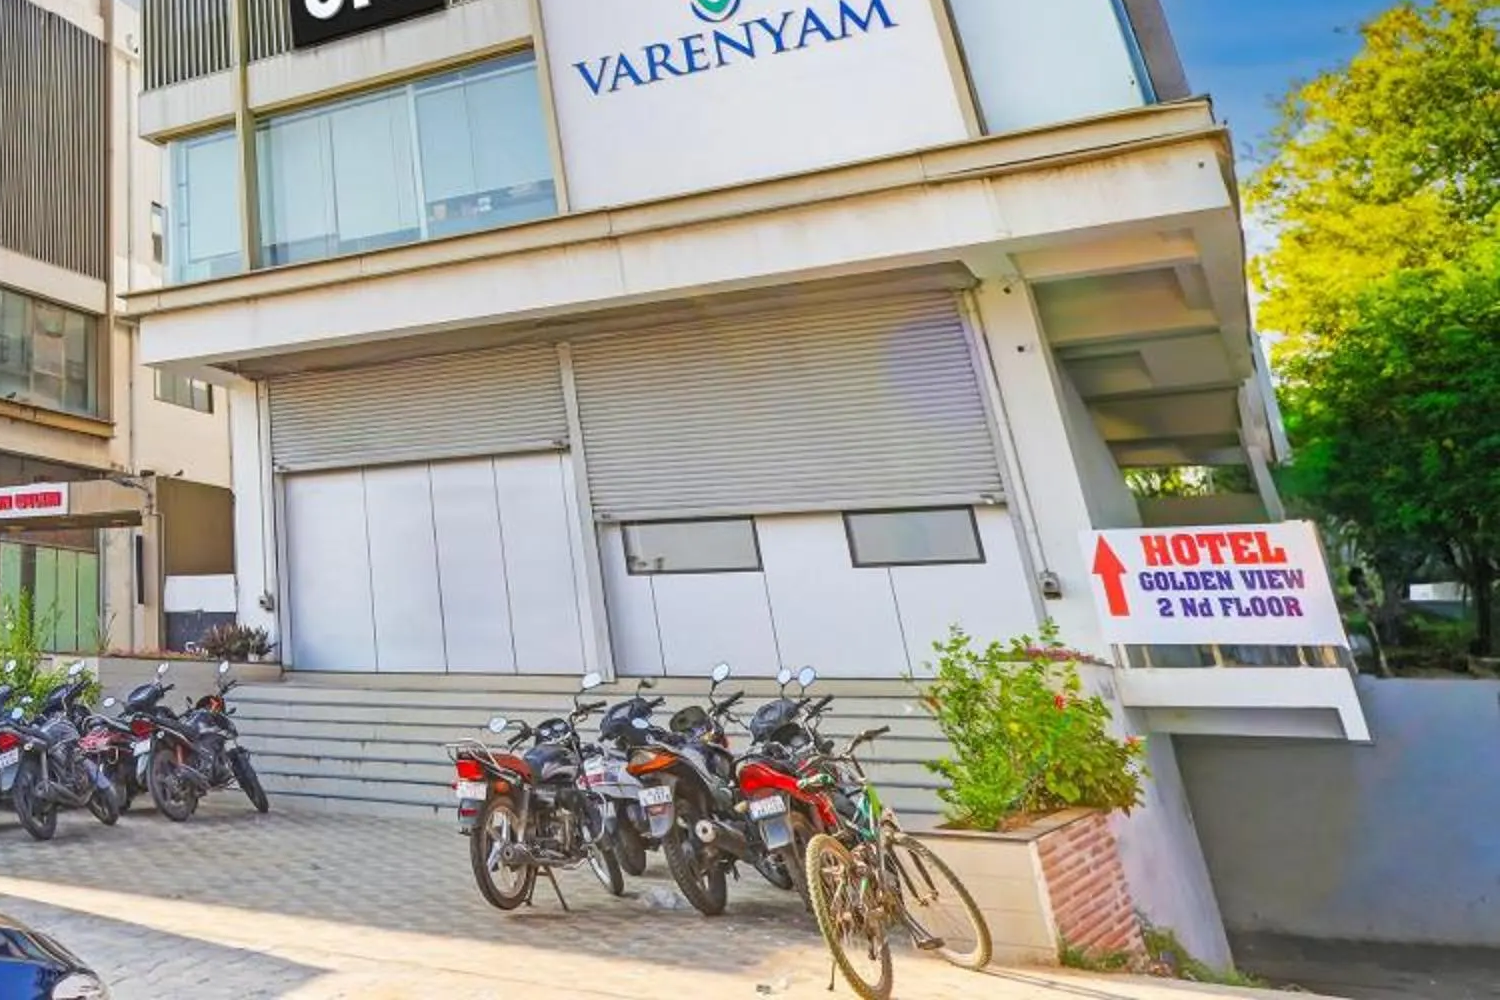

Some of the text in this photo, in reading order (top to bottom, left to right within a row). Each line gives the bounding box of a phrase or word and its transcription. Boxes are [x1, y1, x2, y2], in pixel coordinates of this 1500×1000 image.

[1139, 531, 1287, 567] HOTEL
[1138, 569, 1305, 592] GOLDEN VIEW
[1156, 596, 1304, 618] 2 Nd FLOOR
